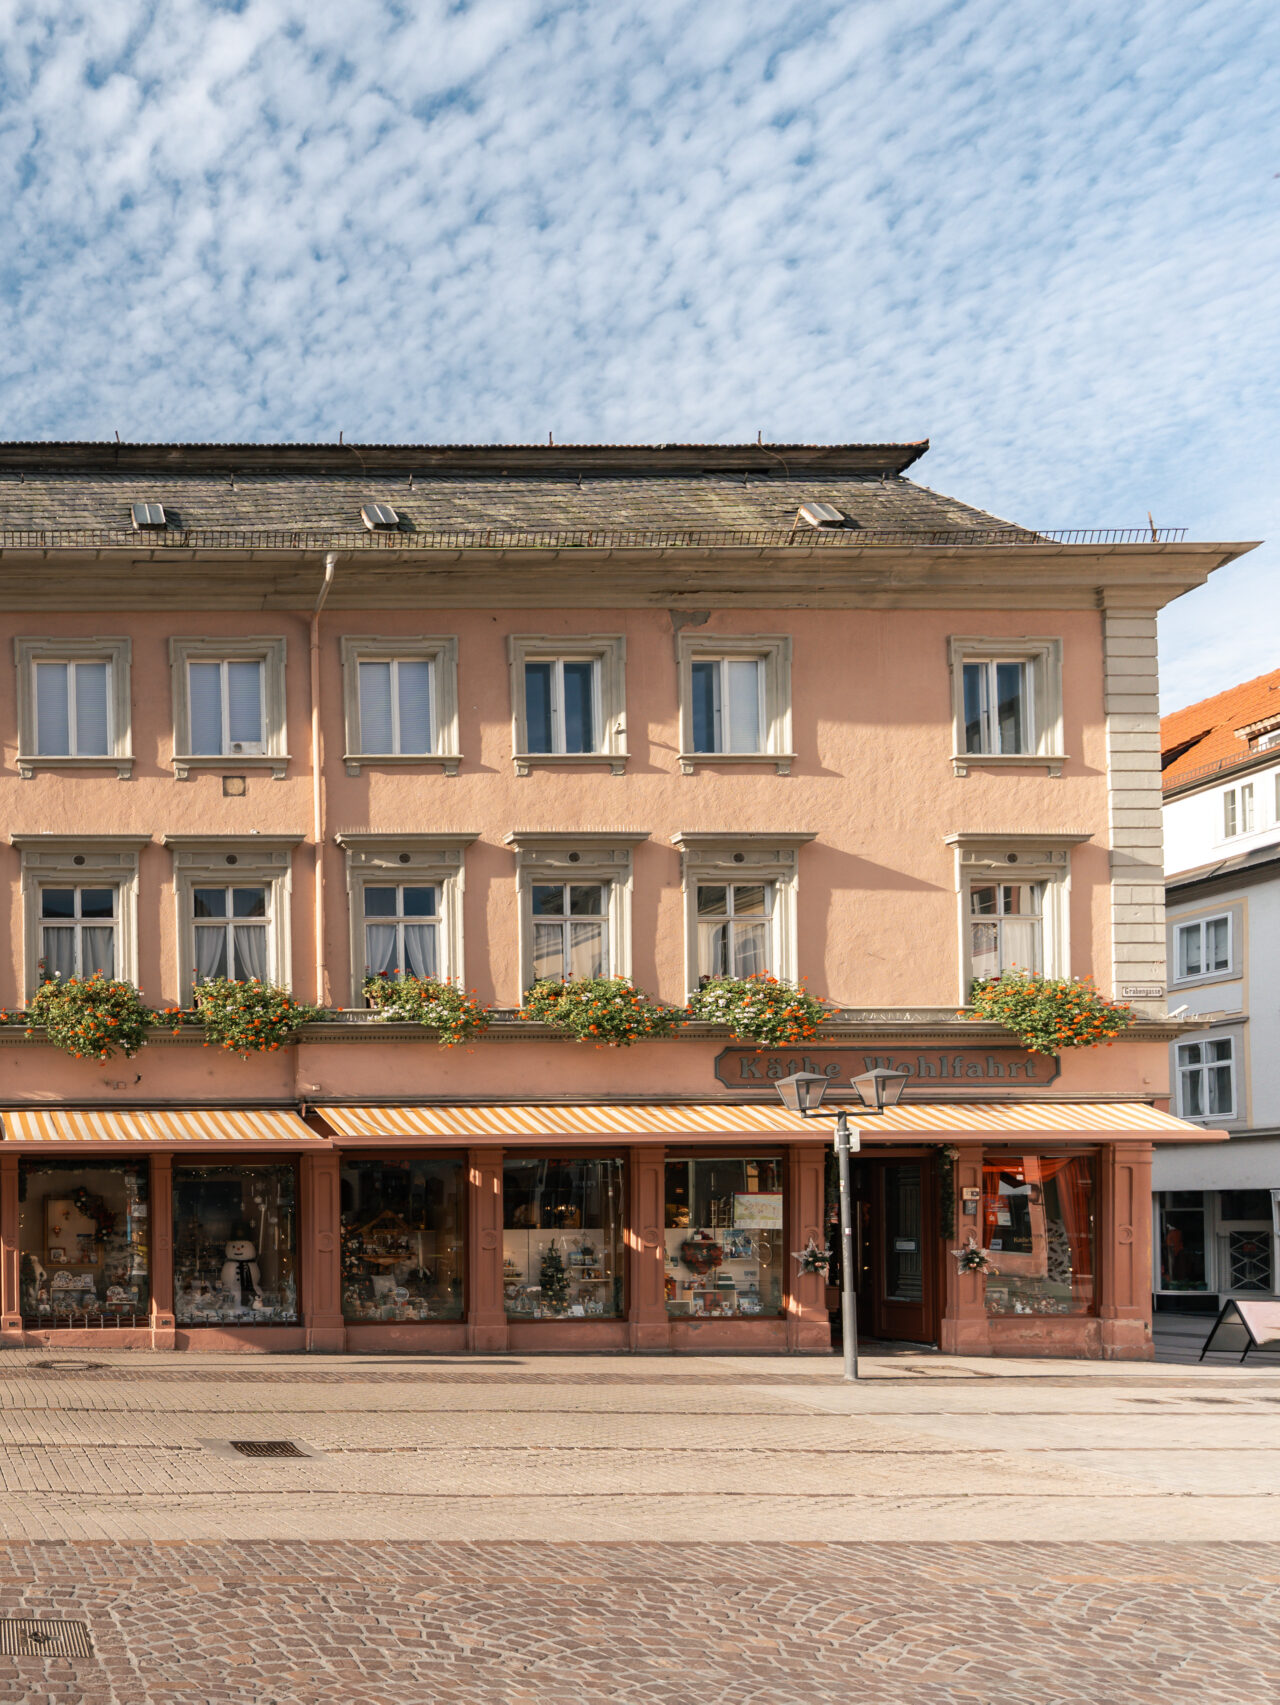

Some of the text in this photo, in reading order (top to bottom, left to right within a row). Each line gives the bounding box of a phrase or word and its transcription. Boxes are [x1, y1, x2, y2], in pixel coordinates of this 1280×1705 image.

[1124, 987, 1161, 997] Grabengasse
[739, 1056, 1037, 1078] Käthe Wohlfahrt
